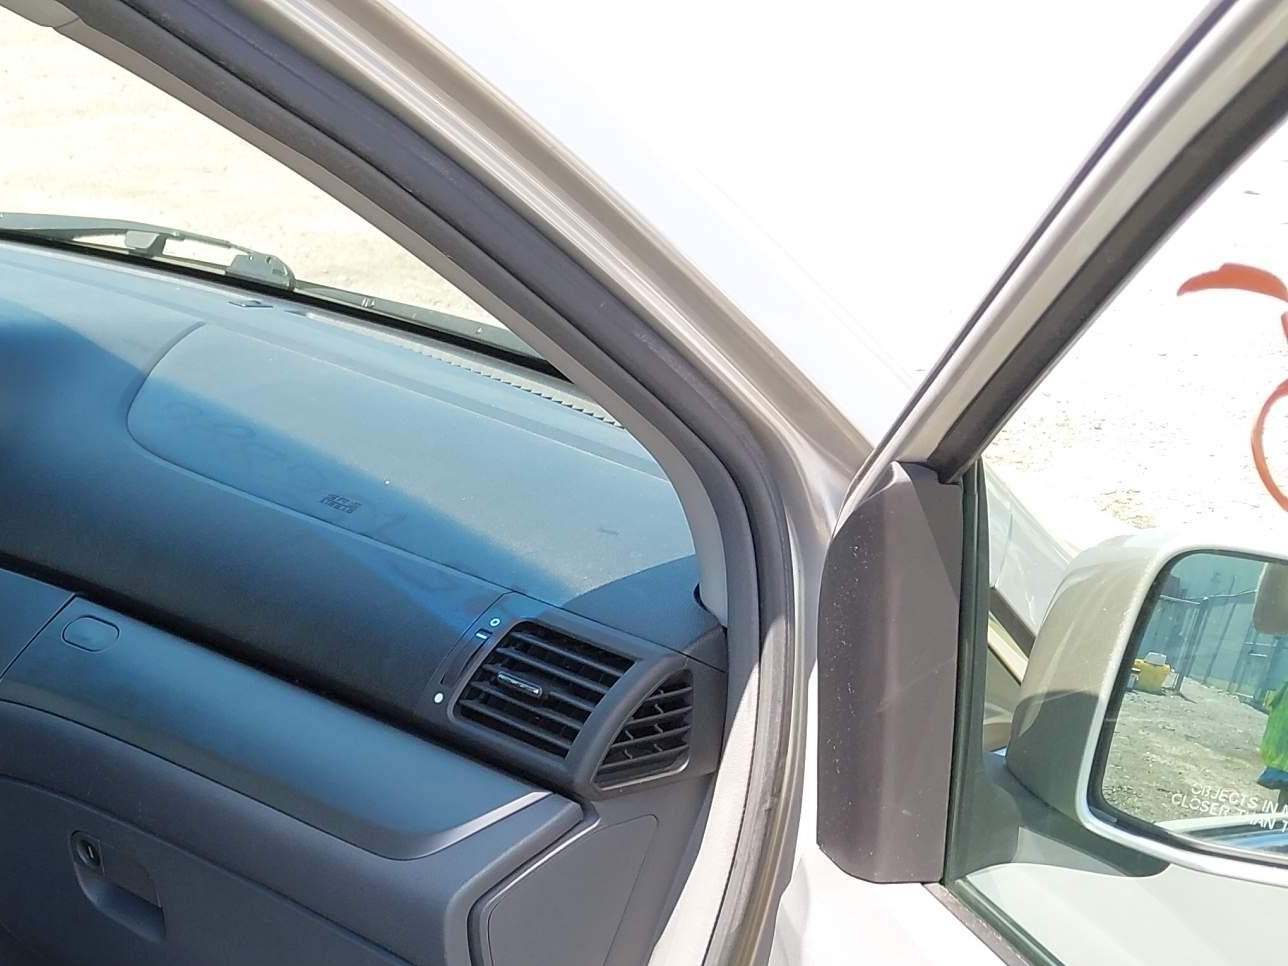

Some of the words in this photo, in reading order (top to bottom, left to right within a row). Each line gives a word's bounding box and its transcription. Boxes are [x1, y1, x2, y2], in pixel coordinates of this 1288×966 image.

[1171, 793, 1231, 816] CLOSER
[1192, 783, 1259, 809] OBJECTS
[1262, 799, 1279, 815] IN
